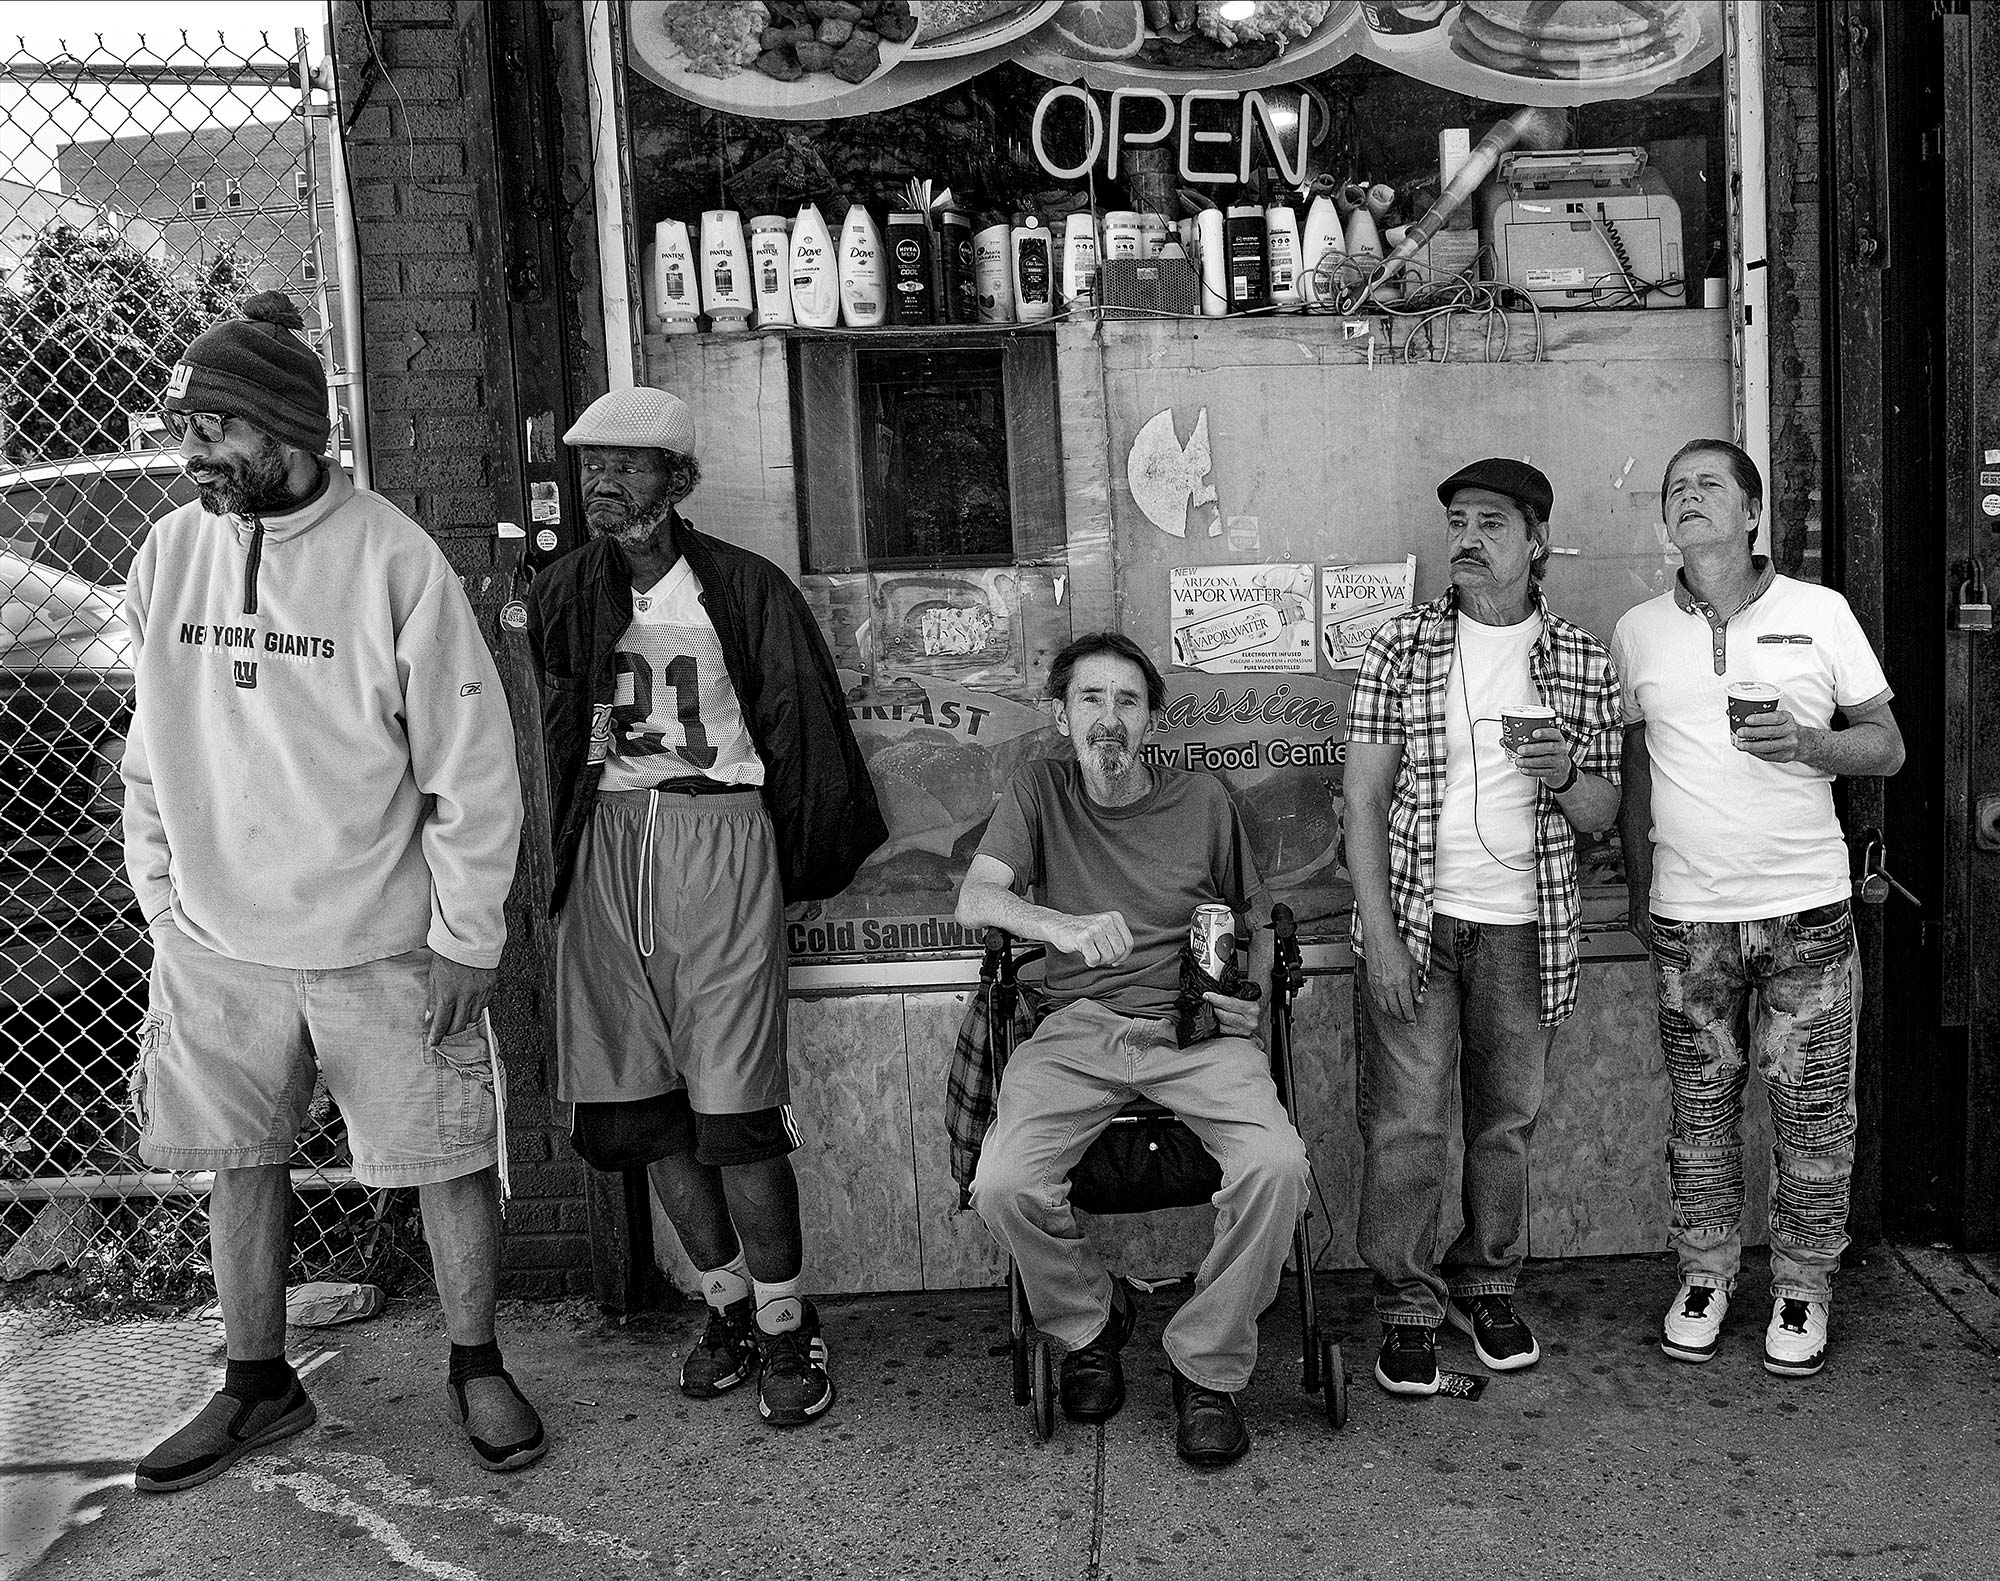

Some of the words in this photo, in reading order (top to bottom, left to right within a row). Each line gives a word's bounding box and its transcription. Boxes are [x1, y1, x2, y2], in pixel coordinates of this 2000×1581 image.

[1032, 85, 1310, 185] OPEN
[797, 246, 822, 257] Dove
[850, 247, 874, 258] Dove
[1174, 568, 1198, 576] NEW
[1183, 577, 1238, 587] ARIZONA
[1333, 574, 1389, 584] ARIZONA
[1174, 588, 1227, 602] VAPOR
[1229, 588, 1283, 601] WATER
[1325, 585, 1378, 599] VAPOR
[1380, 586, 1405, 599] WA
[180, 623, 208, 645] NE
[213, 625, 257, 649] YORK
[264, 631, 335, 659] GIANTS
[1193, 630, 1231, 648] VAPOR
[1230, 618, 1269, 637] WATER
[611, 652, 719, 769] 21
[1157, 684, 1339, 733] assim
[1184, 740, 1260, 771] Food
[1266, 735, 1346, 768] Cente
[787, 921, 856, 953] Cold
